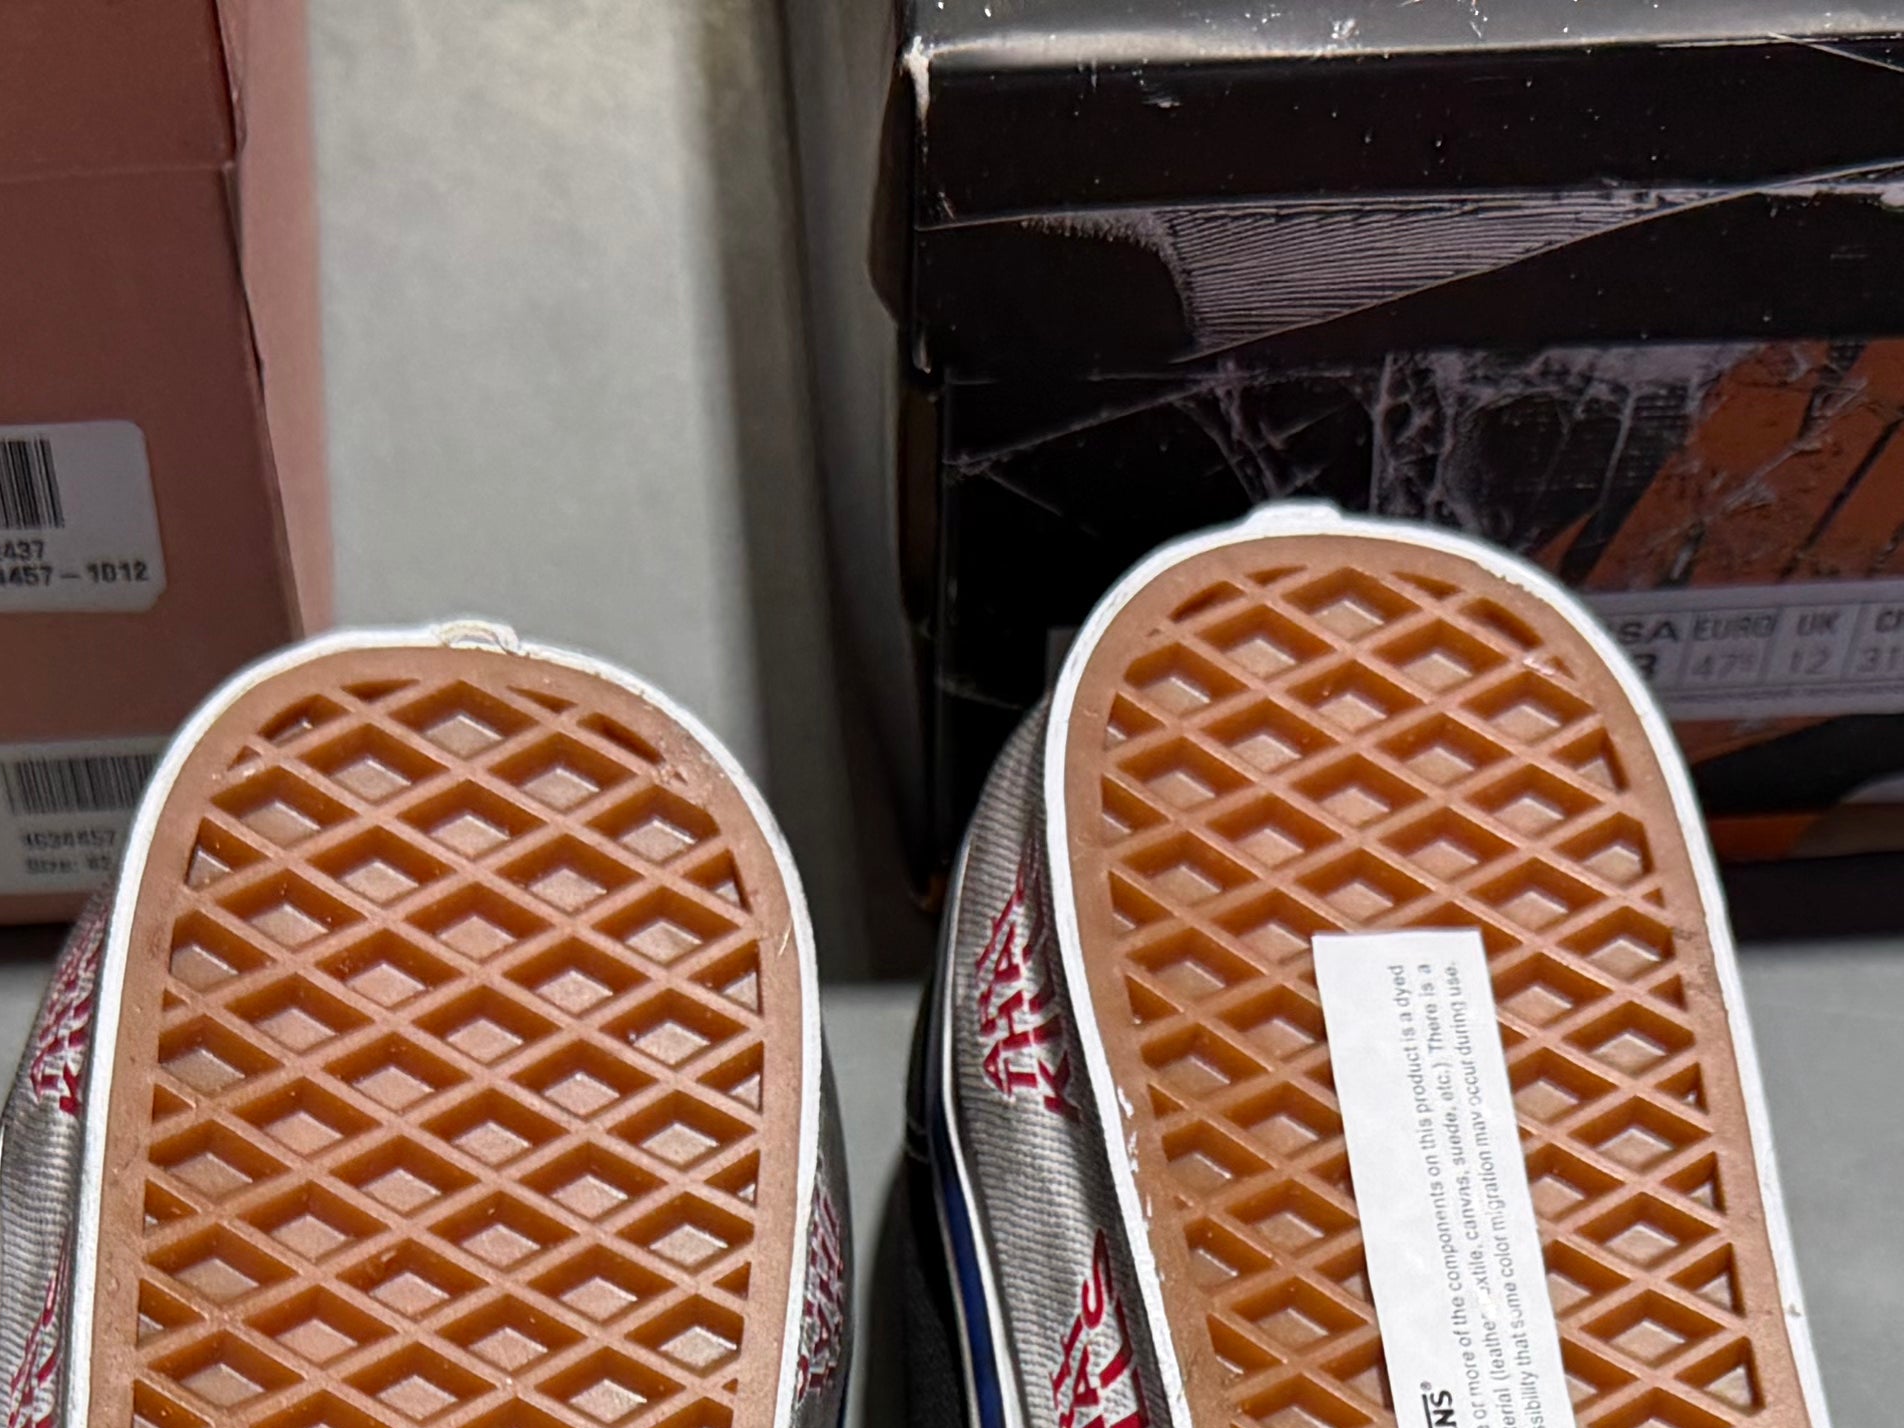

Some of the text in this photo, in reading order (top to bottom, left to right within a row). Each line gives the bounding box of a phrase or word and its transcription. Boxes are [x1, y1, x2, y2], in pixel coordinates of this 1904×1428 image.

[1693, 613, 1777, 642] EURO
[1797, 610, 1840, 637] UK
[1387, 964, 1413, 1008] dyed
[1399, 1011, 1413, 1023] a
[1399, 1026, 1416, 1043] is
[1424, 1003, 1444, 1054] There
[1449, 1000, 1472, 1056] during
[1403, 1046, 1434, 1114] product
[1460, 1060, 1483, 1107] occur
[1415, 1117, 1436, 1151] this
[1425, 1154, 1441, 1178] on
[1477, 1150, 1507, 1232] migration
[1430, 1179, 1463, 1292] components
[1492, 1234, 1515, 1279] color
[1450, 1295, 1468, 1326] the
[1452, 1330, 1472, 1348] of
[1510, 1331, 1532, 1367] that
[1462, 1350, 1481, 1397] more
[1471, 1400, 1488, 1420] or
